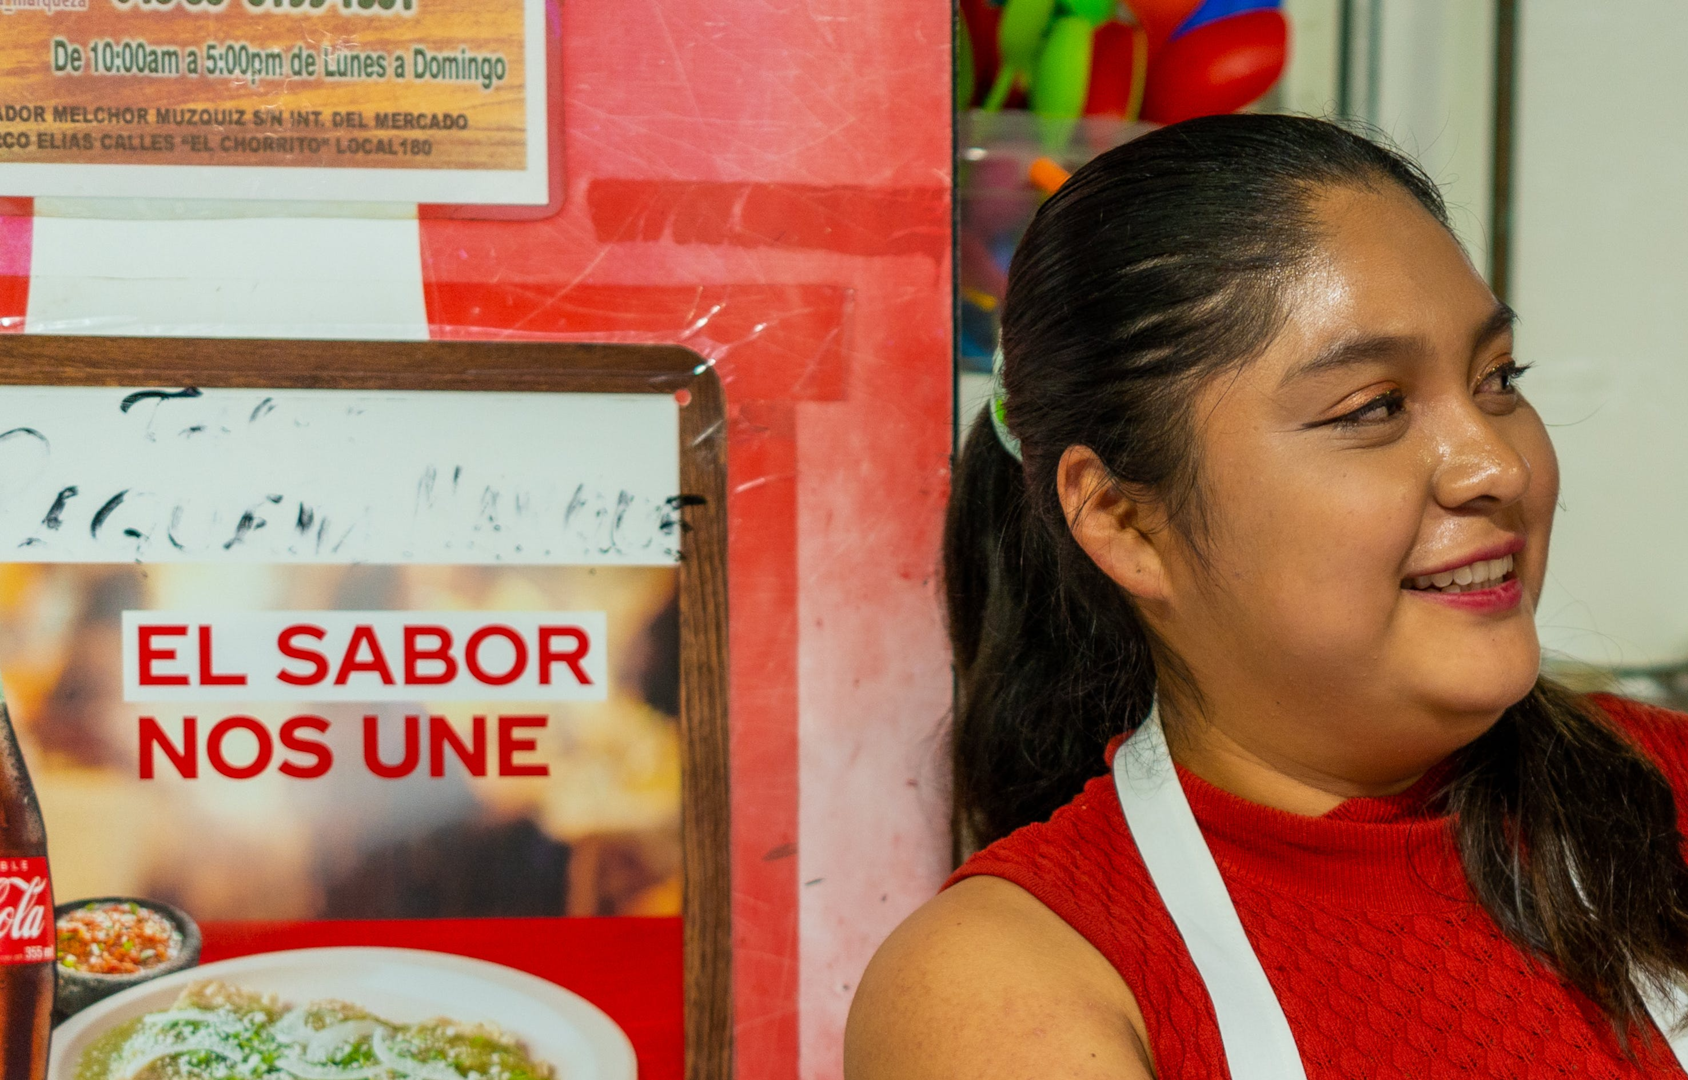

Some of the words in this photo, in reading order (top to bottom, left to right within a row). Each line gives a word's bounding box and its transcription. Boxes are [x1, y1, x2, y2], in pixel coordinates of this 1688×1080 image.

[54, 39, 82, 72] De
[91, 41, 180, 74] 10:00am
[187, 49, 199, 74] a
[206, 44, 283, 85] 5:00pm
[290, 45, 316, 76] de
[324, 46, 387, 78] Lunes
[394, 54, 405, 78] a
[414, 48, 506, 89] Domingo
[53, 106, 148, 124] MELCHOR
[156, 108, 246, 126] MUZQUIZ
[290, 110, 325, 128] INT.
[332, 111, 368, 128] DEL
[374, 112, 469, 130] MERCADO
[0, 131, 30, 149] CO
[37, 132, 94, 150] ELIAS
[100, 134, 175, 151] CALLES
[137, 624, 247, 686] EL
[277, 624, 594, 686] SABOR
[138, 715, 333, 780] NOS
[362, 714, 550, 779] UNE
[24, 945, 42, 961] 355
